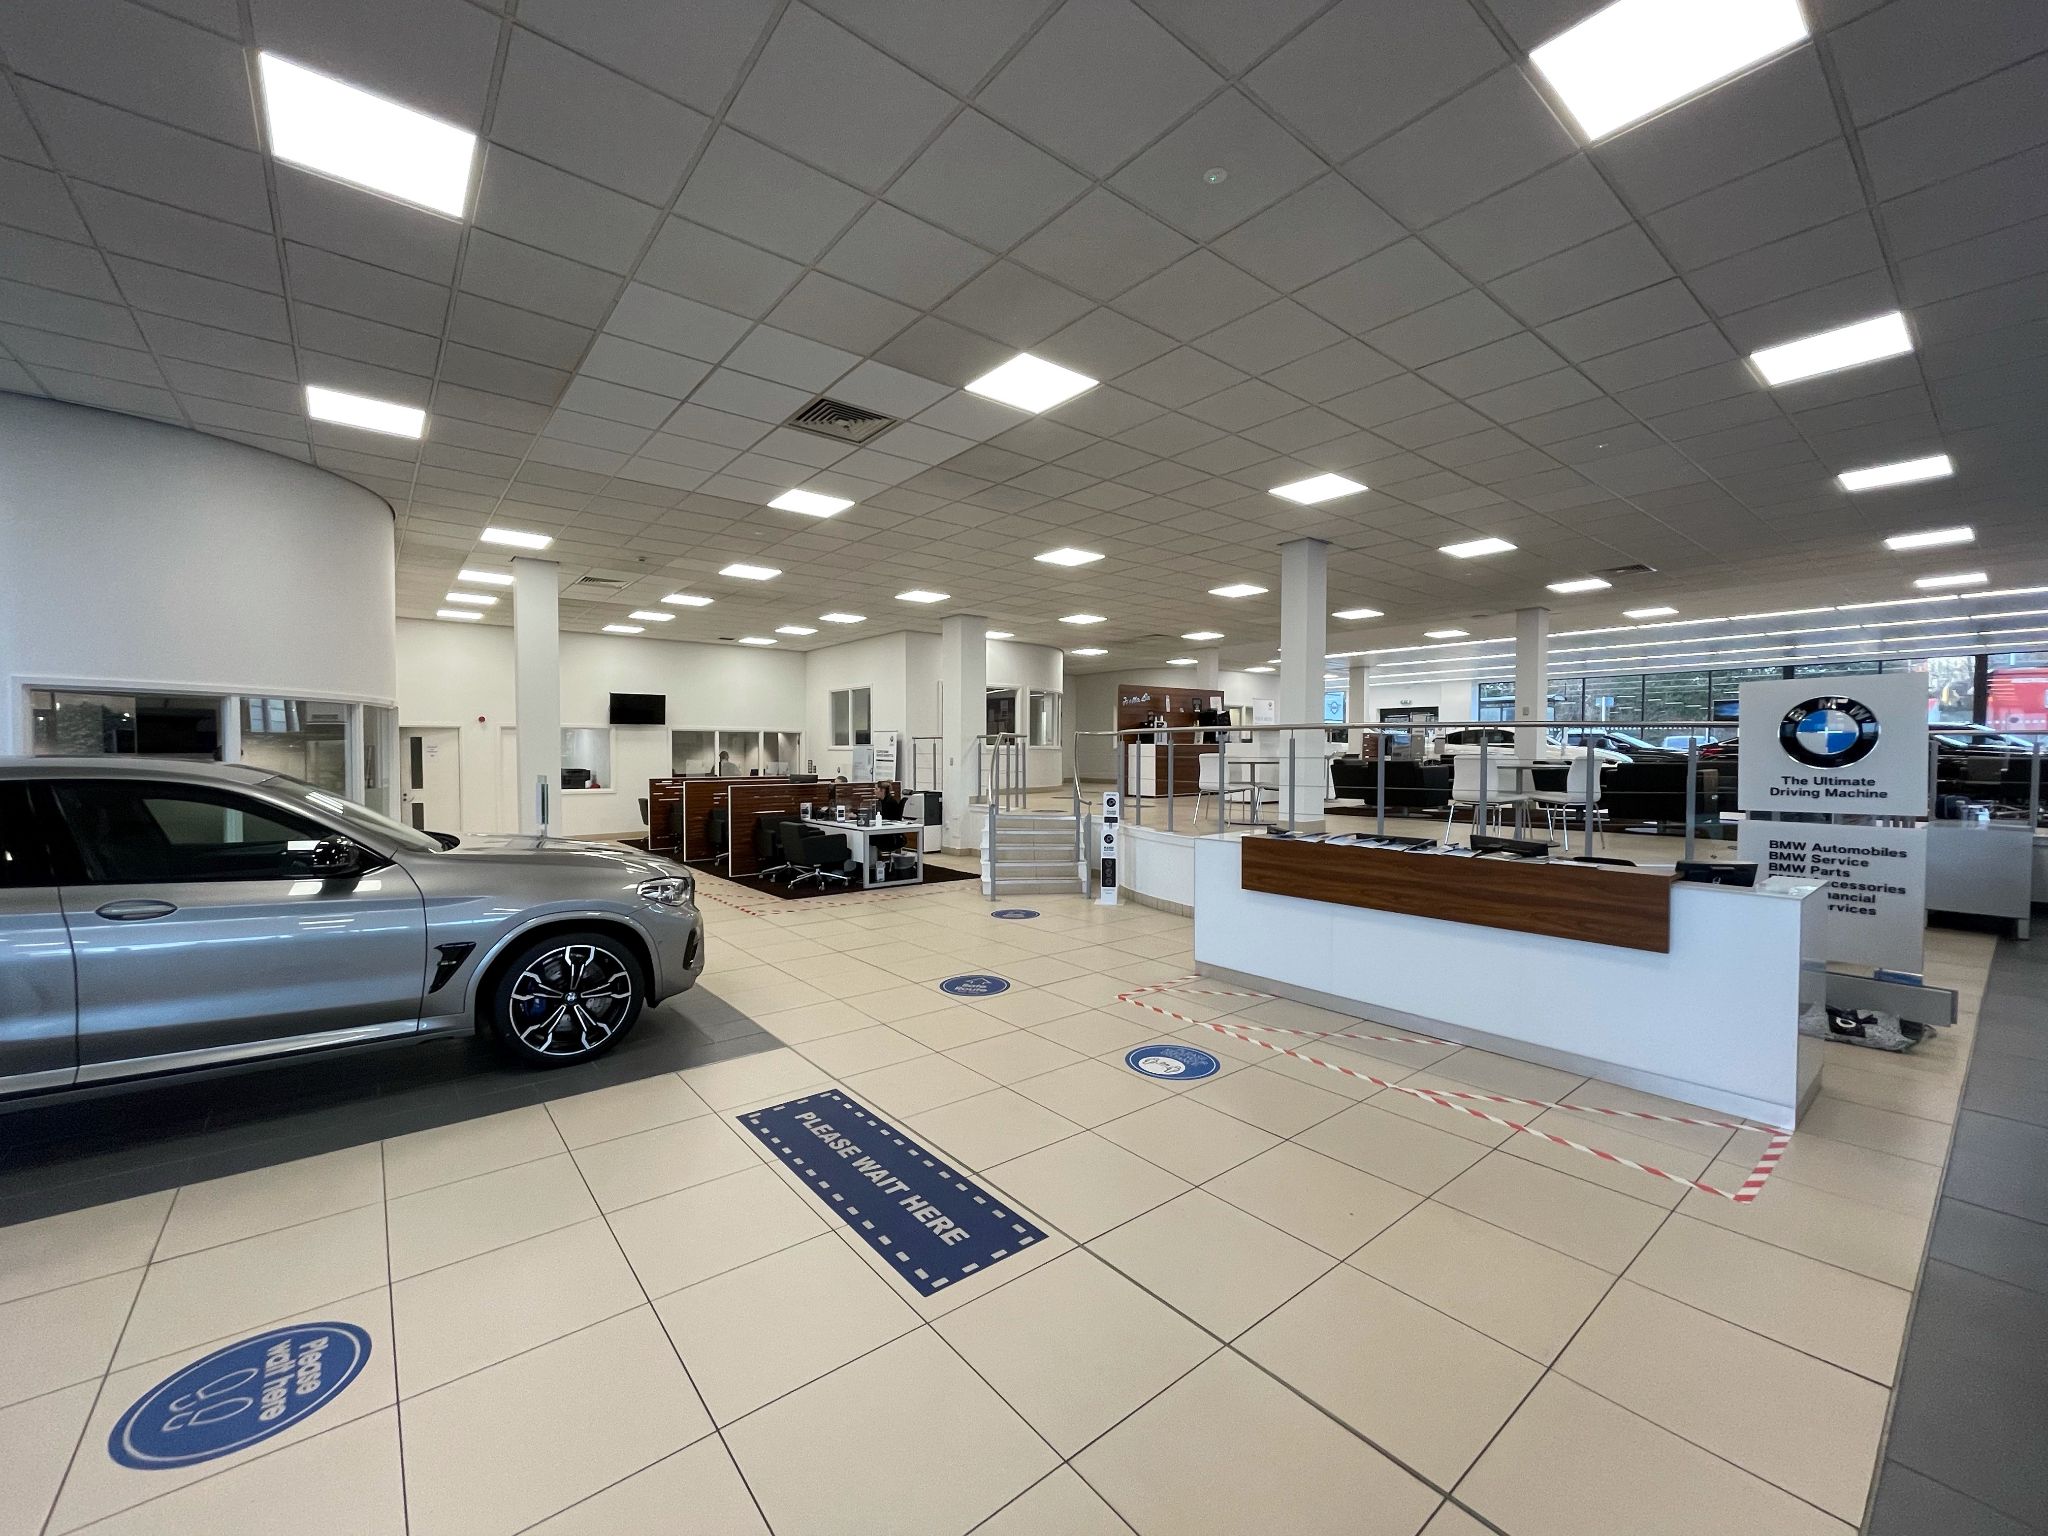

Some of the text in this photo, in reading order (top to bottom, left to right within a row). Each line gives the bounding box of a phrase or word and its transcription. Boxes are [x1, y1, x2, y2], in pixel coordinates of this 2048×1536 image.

[1788, 698, 1872, 722] BMW
[1781, 776, 1876, 786] The Ultimate
[1770, 787, 1888, 799] Driving Machine
[1769, 840, 1908, 858] BMW Automobiles
[1769, 851, 1870, 868] BMW Service
[1768, 862, 1806, 873] BMW
[1810, 865, 1850, 878] Parts
[1821, 879, 1906, 895] cessories
[1827, 903, 1877, 916] rvices
[795, 1111, 971, 1246] PLEASE WAIT HERE
[295, 1336, 329, 1395] please
[259, 1338, 297, 1421] wait here
